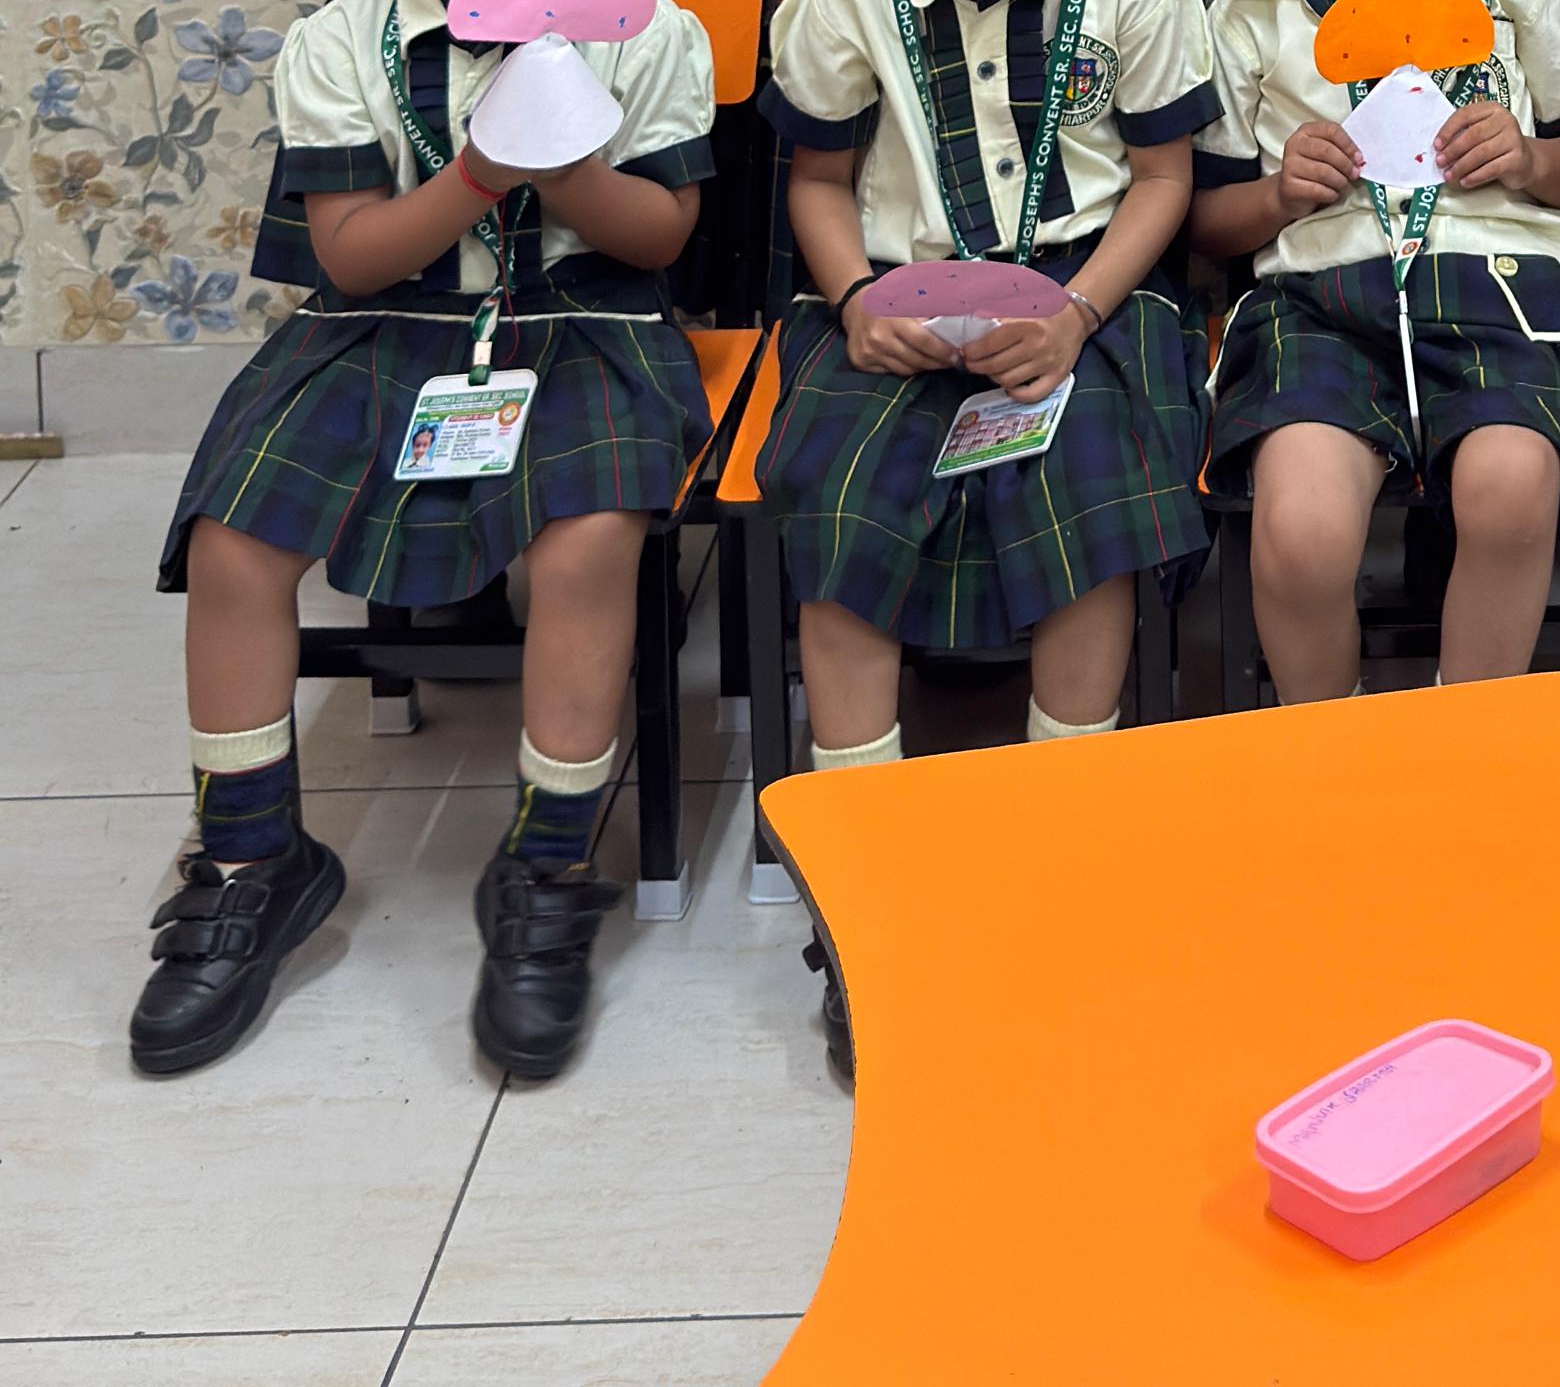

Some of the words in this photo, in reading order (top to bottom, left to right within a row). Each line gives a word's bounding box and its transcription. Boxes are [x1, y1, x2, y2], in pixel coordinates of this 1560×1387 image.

[1059, 19, 1078, 53] SEC.
[384, 45, 398, 78] SEC.
[910, 49, 924, 84] SEC.
[1054, 58, 1071, 83] SR.
[401, 110, 445, 170] ONVENT
[1036, 85, 1064, 167] CONVENT
[1021, 172, 1044, 247] JOSEPH'S
[1412, 213, 1428, 232] ST.
